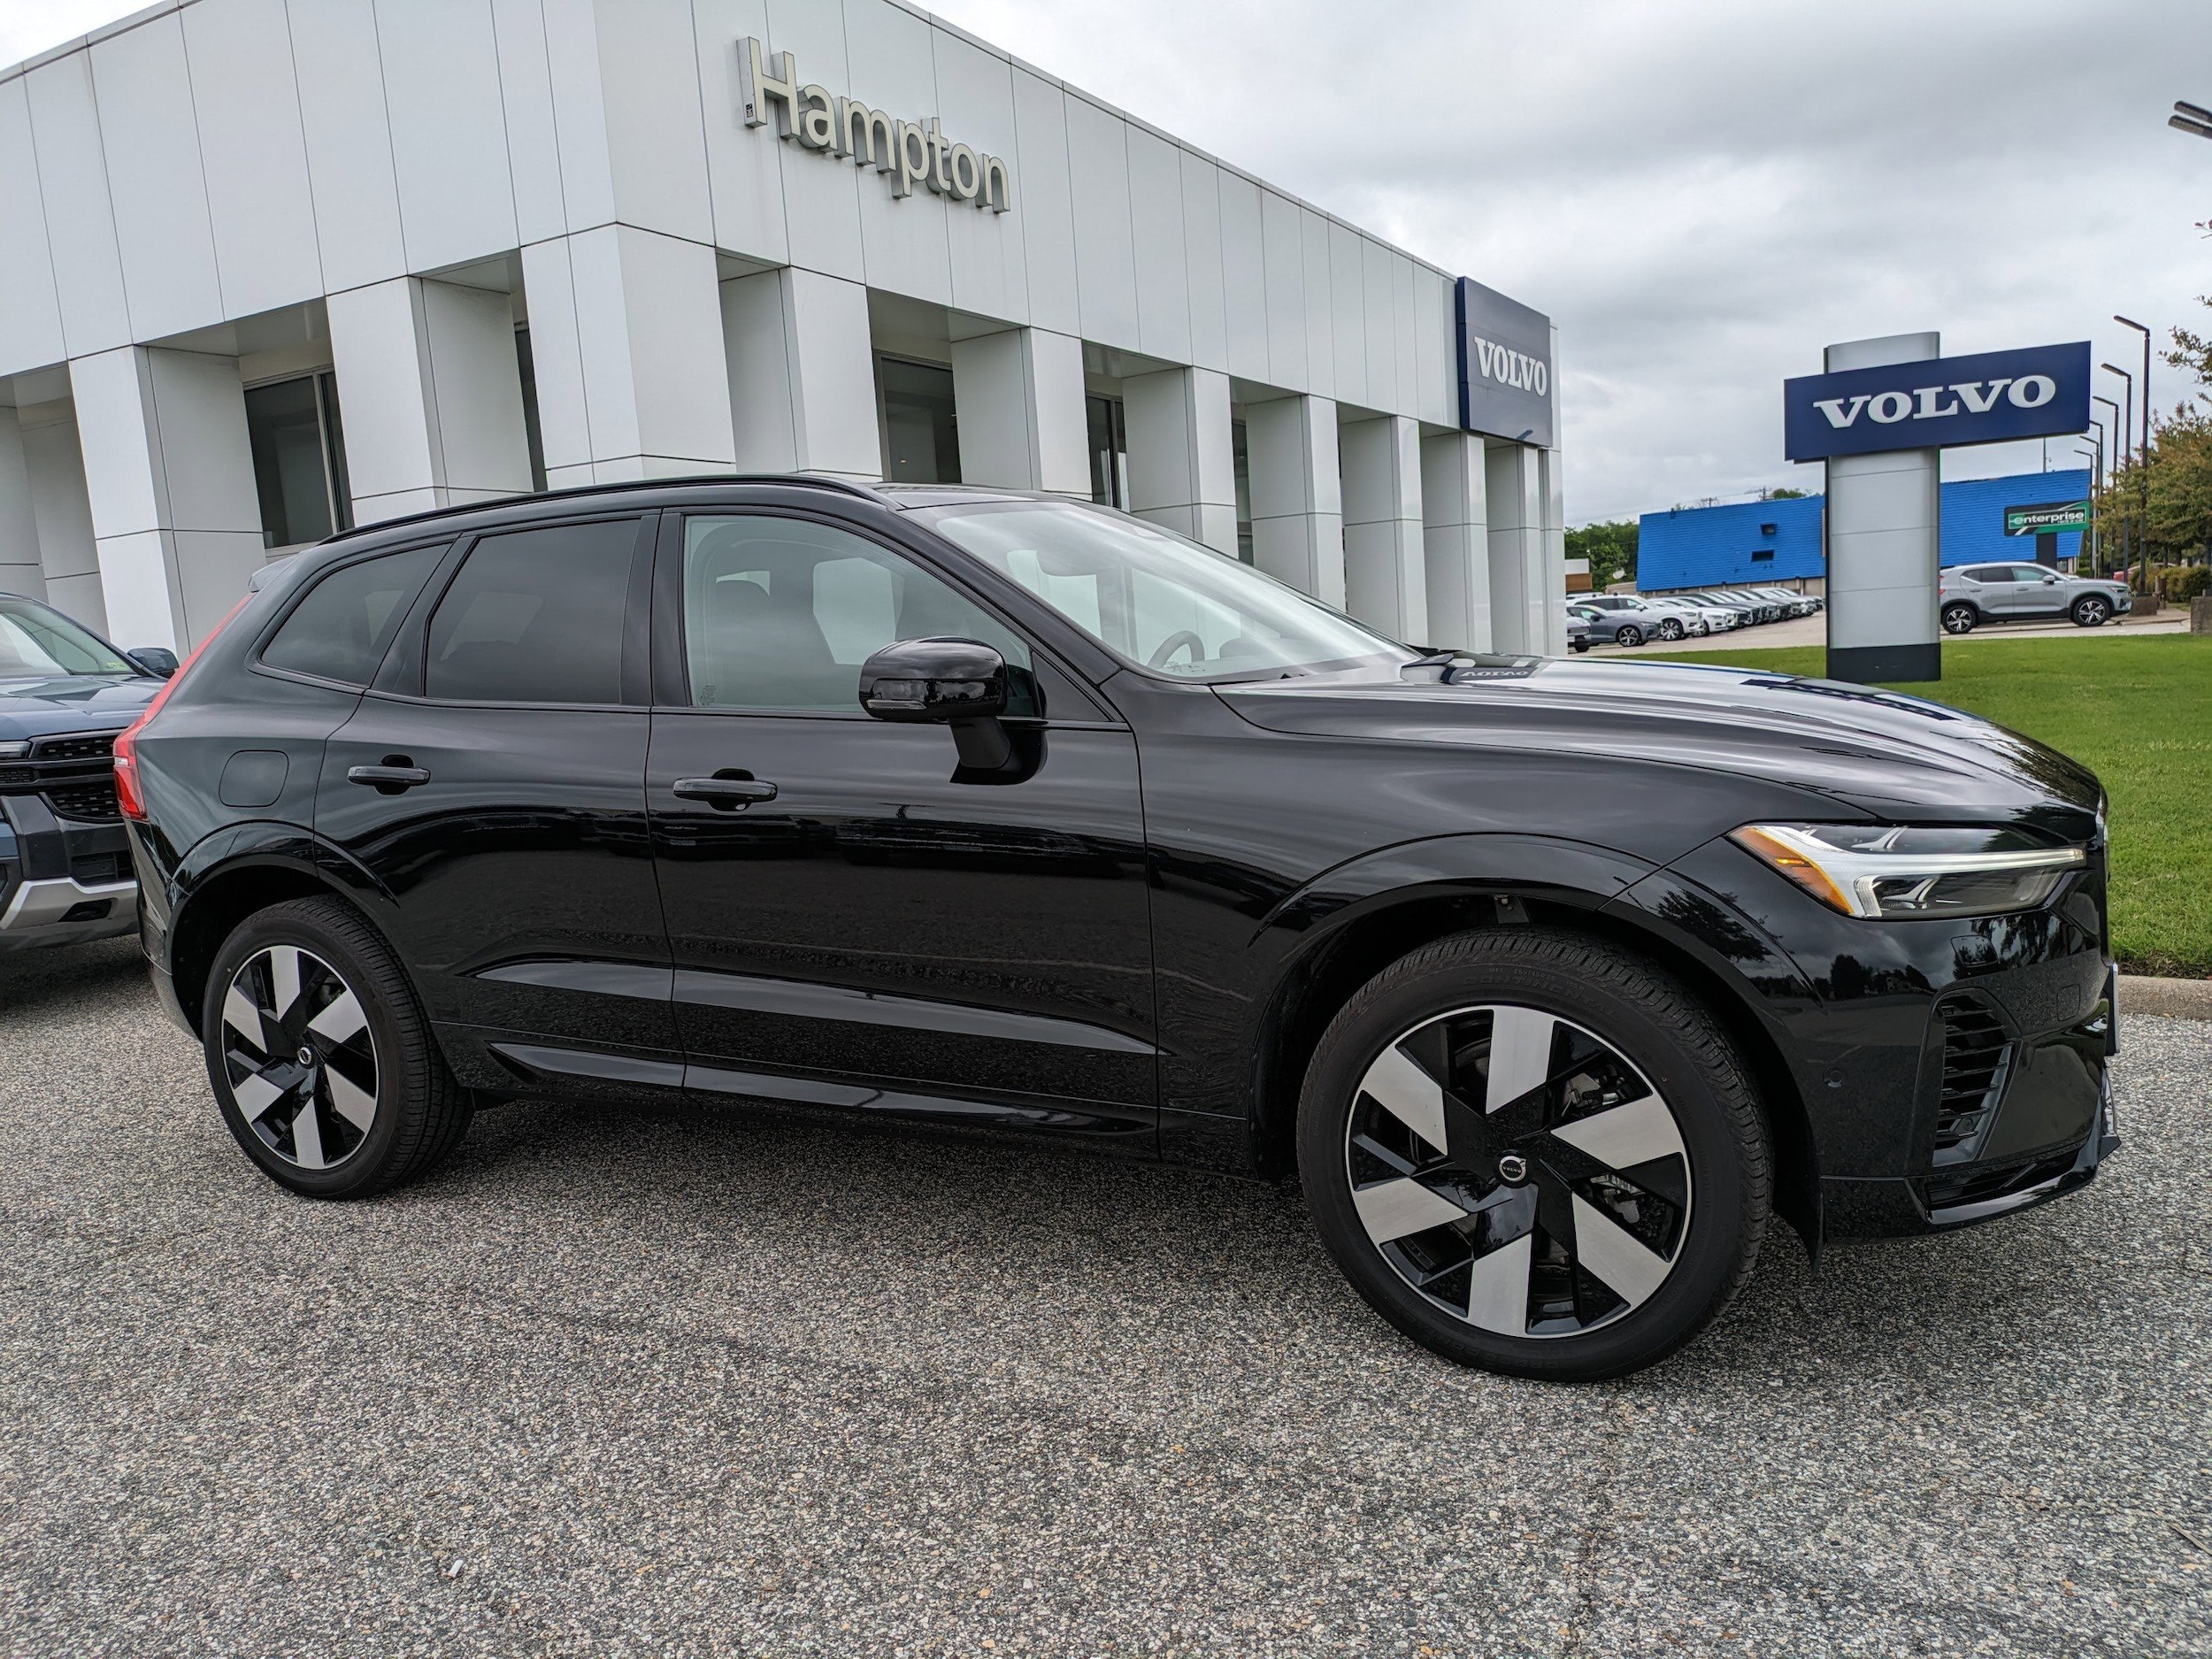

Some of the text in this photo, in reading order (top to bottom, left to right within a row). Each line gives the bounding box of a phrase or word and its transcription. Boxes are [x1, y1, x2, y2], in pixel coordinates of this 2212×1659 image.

[736, 36, 1010, 213] Hampton
[1473, 335, 1548, 396] VOLVO
[1813, 374, 2056, 429] VOLVO
[2013, 511, 2085, 525] enterprise
